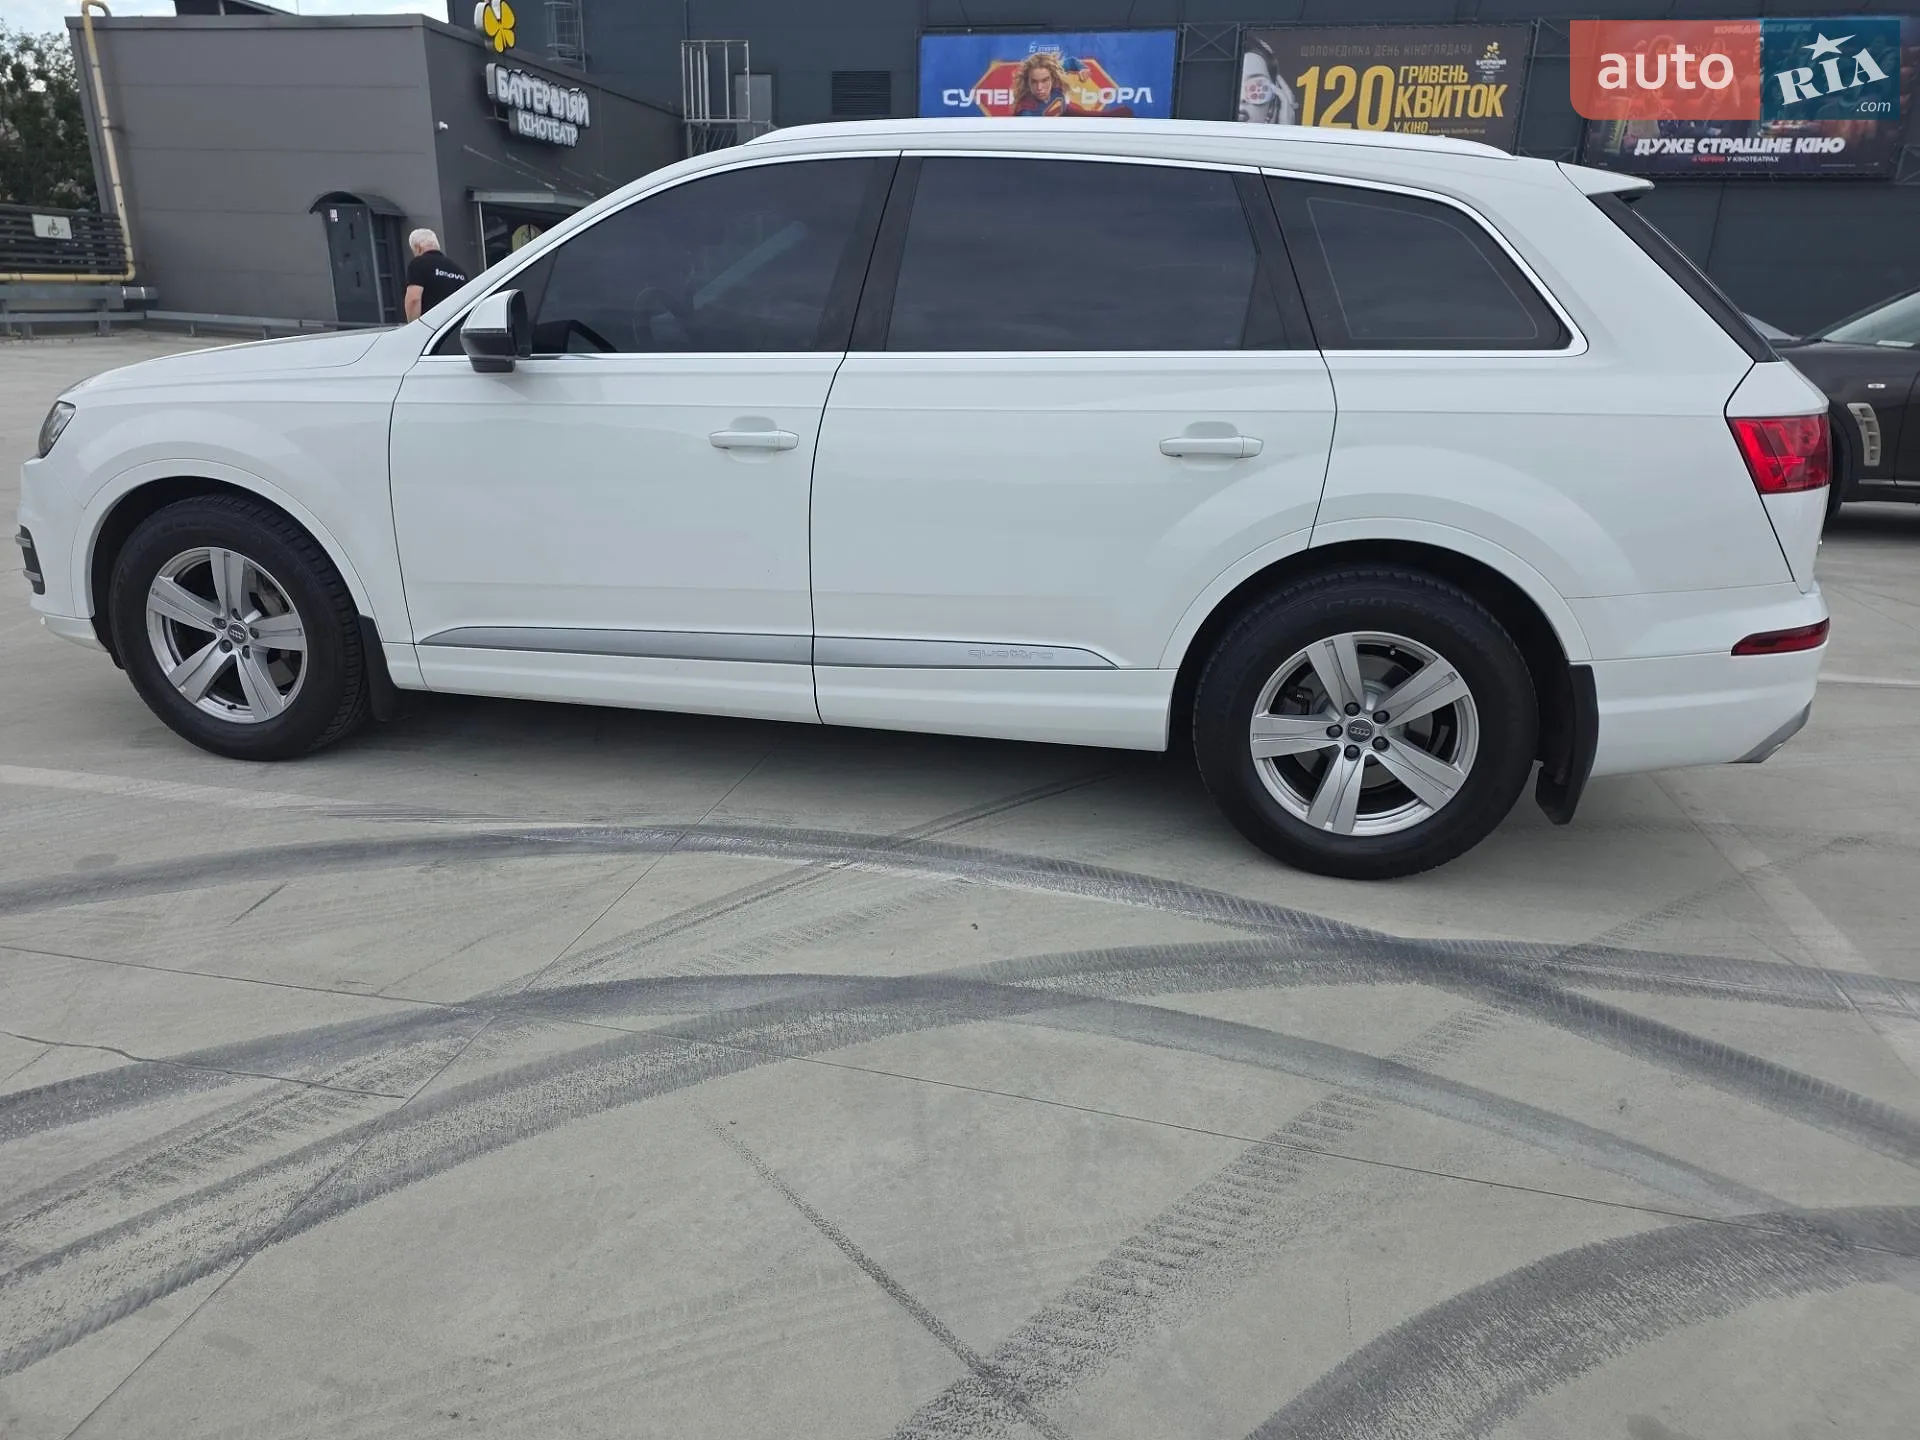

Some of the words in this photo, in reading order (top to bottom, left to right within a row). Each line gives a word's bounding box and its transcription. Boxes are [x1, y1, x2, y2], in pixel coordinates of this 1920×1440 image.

[1399, 65, 1469, 84] ГРИВЕНЬ
[1296, 65, 1395, 132] 120
[1394, 84, 1508, 118] КВИТОК
[517, 110, 580, 147] КІНОТЕАТР
[1393, 121, 1401, 133] У
[1403, 121, 1429, 134] КІНО
[1634, 137, 1696, 156] ДУЖЕ
[1697, 137, 1792, 154] СТРАШНЕ
[1795, 136, 1846, 154] КІНО
